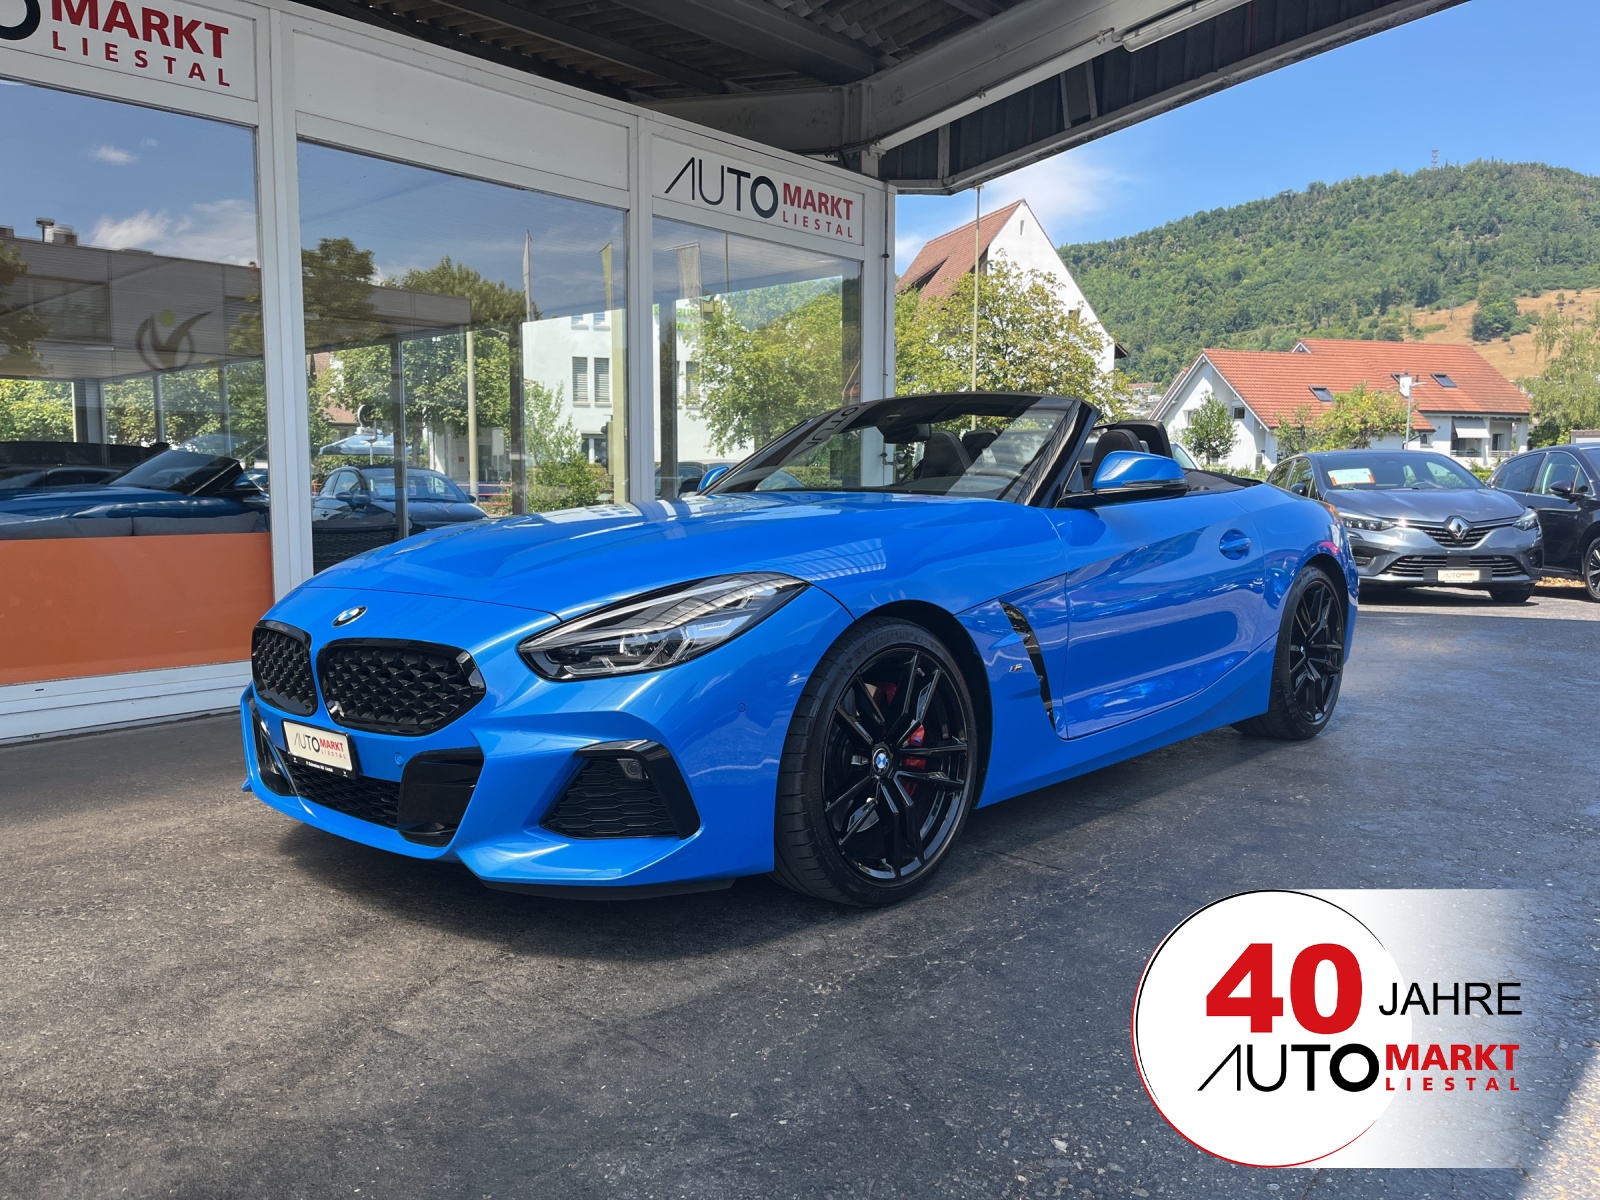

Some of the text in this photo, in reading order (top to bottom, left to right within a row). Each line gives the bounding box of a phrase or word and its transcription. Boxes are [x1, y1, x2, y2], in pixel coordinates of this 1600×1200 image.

[52, 0, 229, 59] MARKT
[52, 31, 230, 87] LIESTAL
[664, 156, 853, 221] AUTO MARKT
[782, 211, 853, 238] LIESTAL
[319, 738, 344, 753] MARKT
